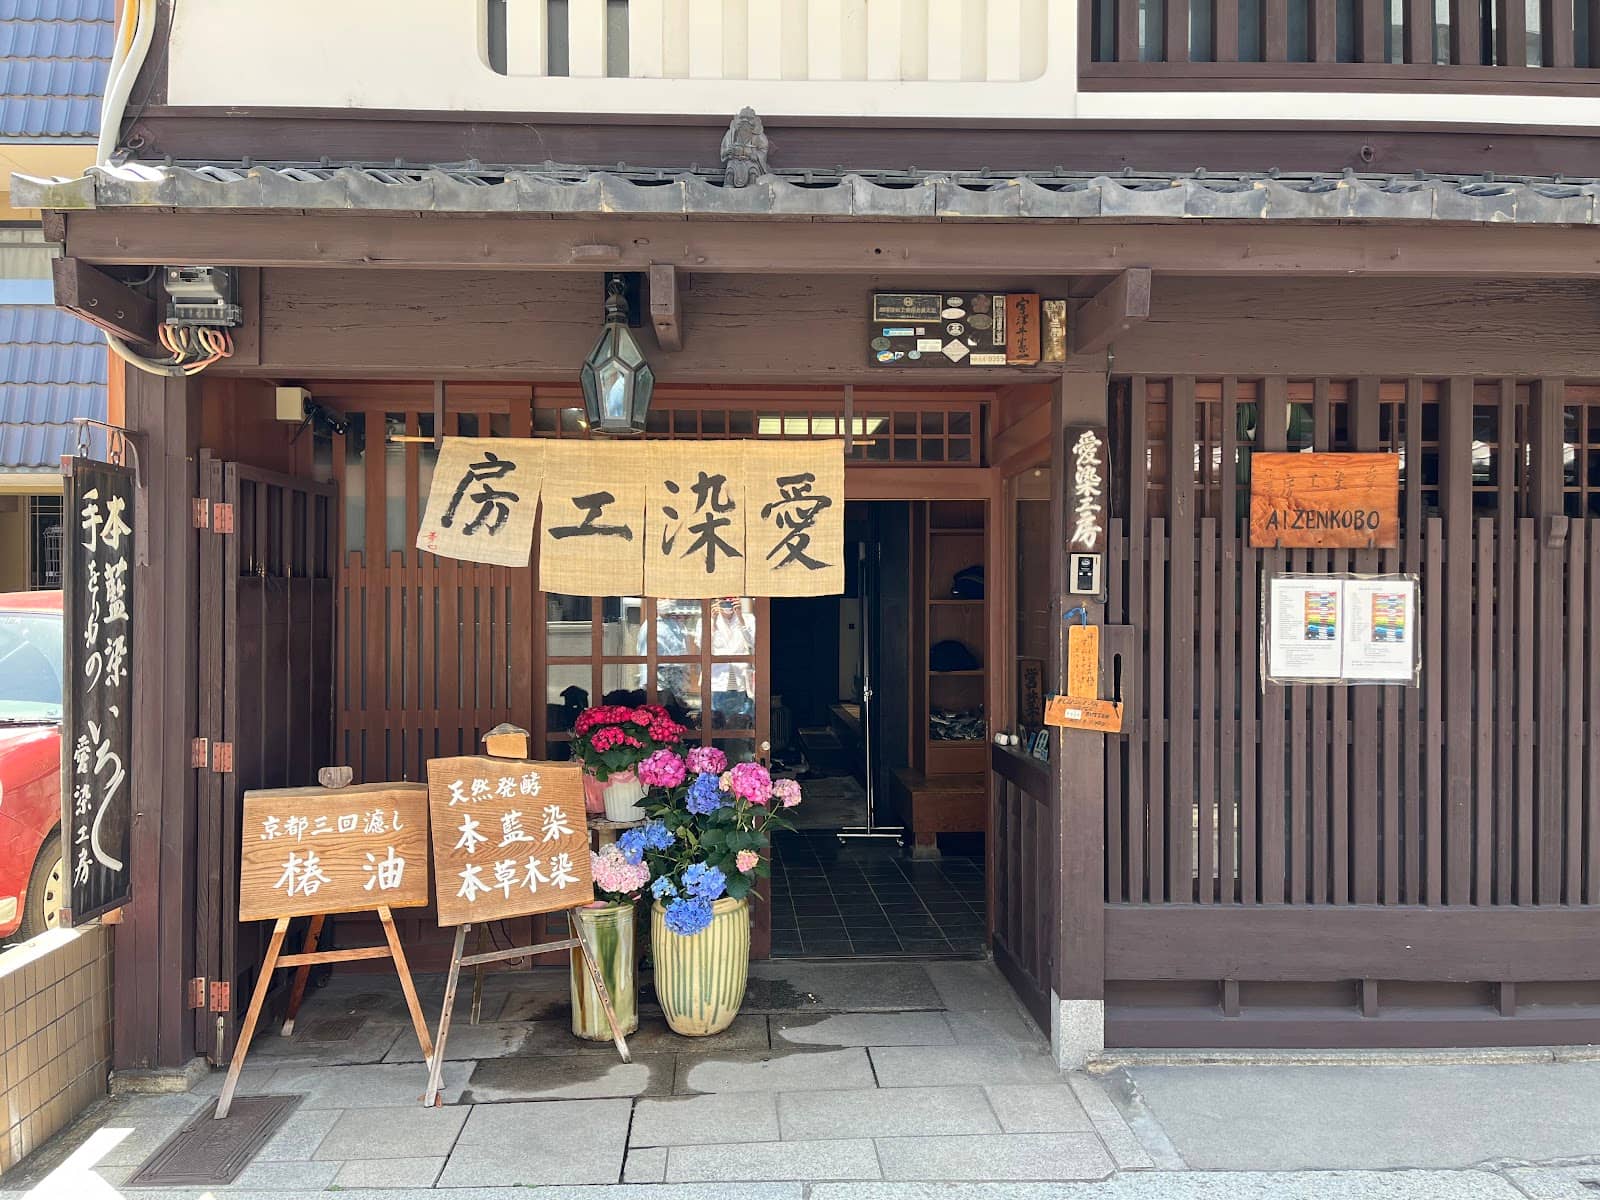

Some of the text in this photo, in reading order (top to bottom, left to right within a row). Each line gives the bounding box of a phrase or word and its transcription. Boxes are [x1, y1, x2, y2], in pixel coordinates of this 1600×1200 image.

[1072, 430, 1103, 548] 愛染工房
[1265, 508, 1380, 531] AIZENKOBO
[99, 494, 132, 687] 本藍染
[73, 734, 94, 889] 愛染工房
[447, 771, 543, 806] 天然発酵
[453, 804, 575, 855] 本藍染
[455, 855, 581, 903] 本草木染
